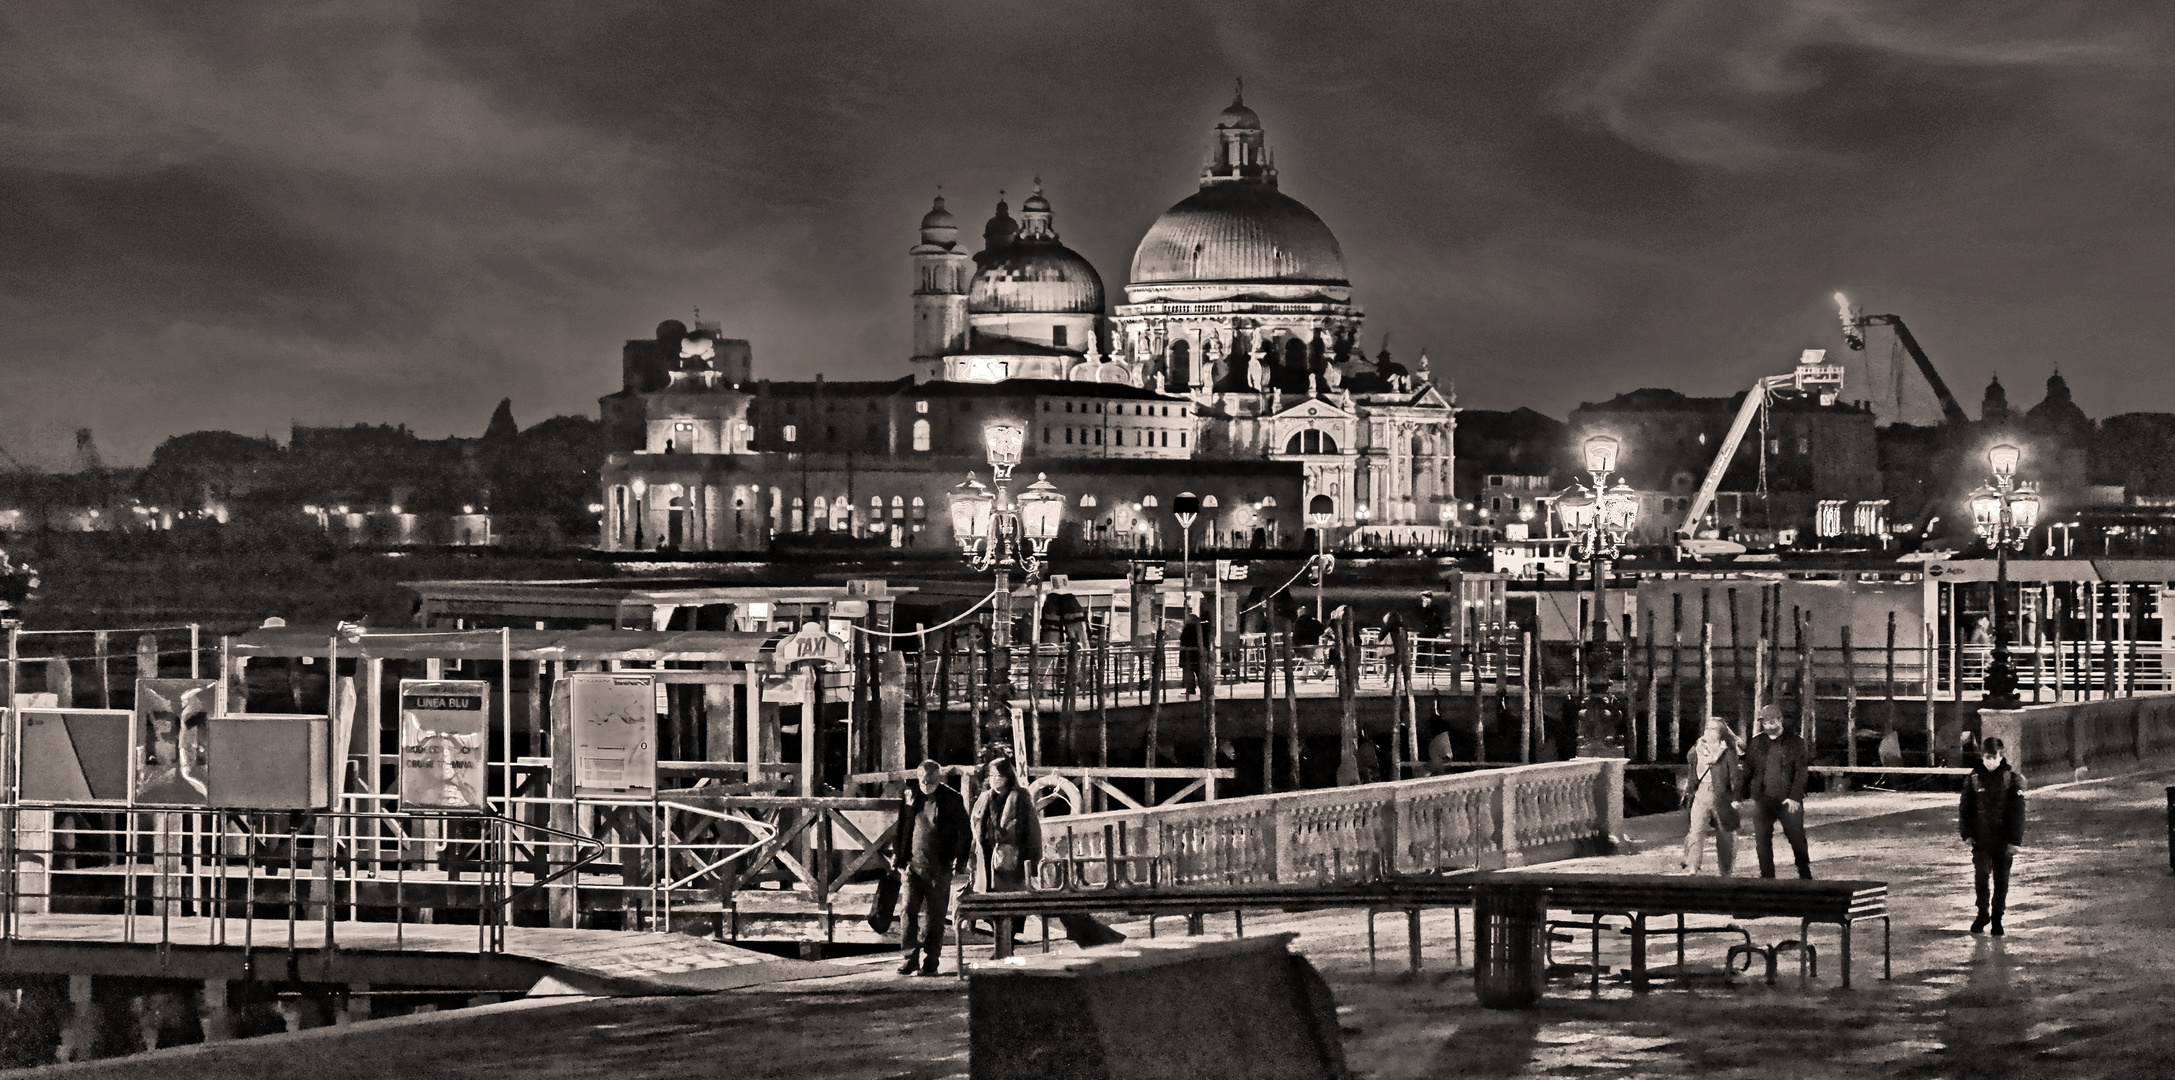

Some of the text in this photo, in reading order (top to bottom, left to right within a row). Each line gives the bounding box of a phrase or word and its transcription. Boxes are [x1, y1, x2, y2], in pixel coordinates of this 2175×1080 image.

[796, 637, 827, 657] TAXI
[416, 698, 469, 708] LINEA BLU
[1015, 715, 1026, 778] TAX
